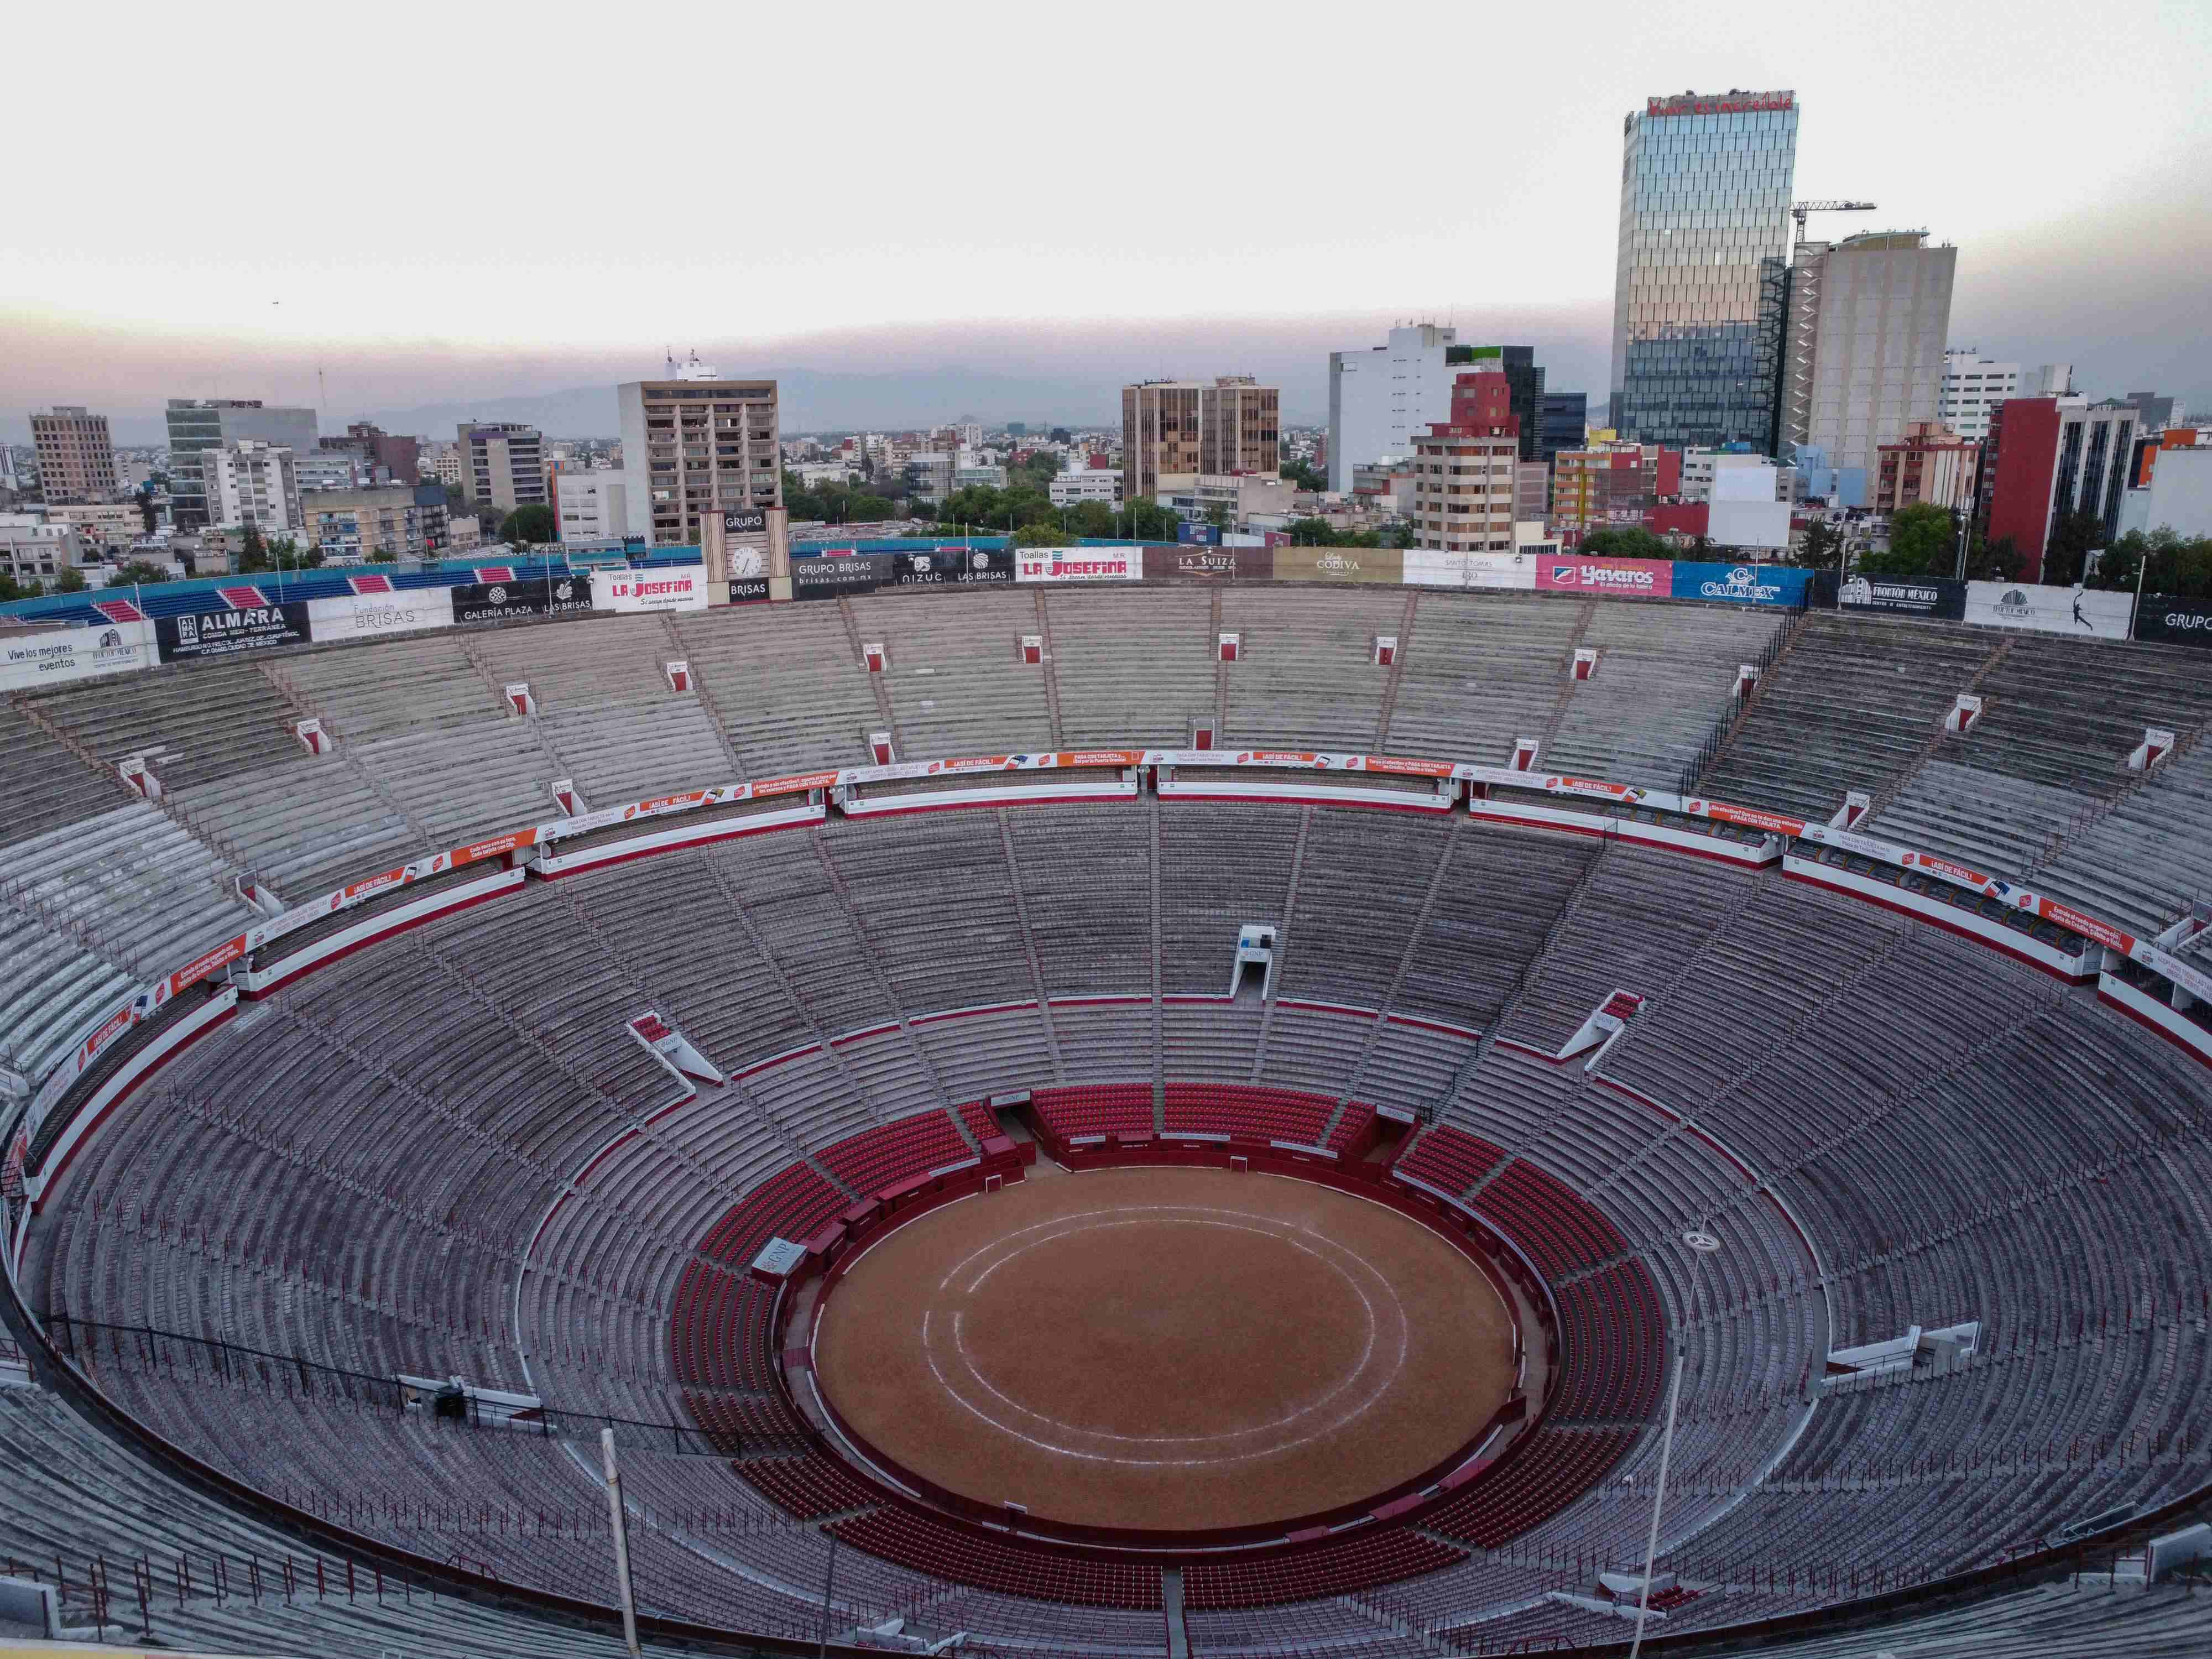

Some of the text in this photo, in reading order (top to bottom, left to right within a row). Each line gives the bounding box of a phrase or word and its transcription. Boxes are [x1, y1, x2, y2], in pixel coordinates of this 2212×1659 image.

[726, 517, 762, 528] GRUPO
[799, 562, 872, 575] GRUPO BRISAS
[1024, 562, 1042, 575] LA
[958, 571, 1006, 581] LAS BRISAS
[612, 584, 628, 597] LA
[731, 584, 765, 596] BRISAS
[1701, 582, 1781, 599] CALMEX
[1872, 586, 1938, 601] FRONTÓN MÉXICO
[354, 603, 394, 614] Fundación
[505, 606, 533, 615] PLAZA
[544, 600, 591, 612] LAS BRISAS
[356, 610, 415, 629] BRISAS
[8, 644, 72, 660] Vive los mejores
[39, 658, 75, 671] eventos
[1945, 865, 1953, 874] DE
[365, 881, 374, 890] DE
[102, 1026, 109, 1039] DE
[769, 1243, 787, 1262] GNP
